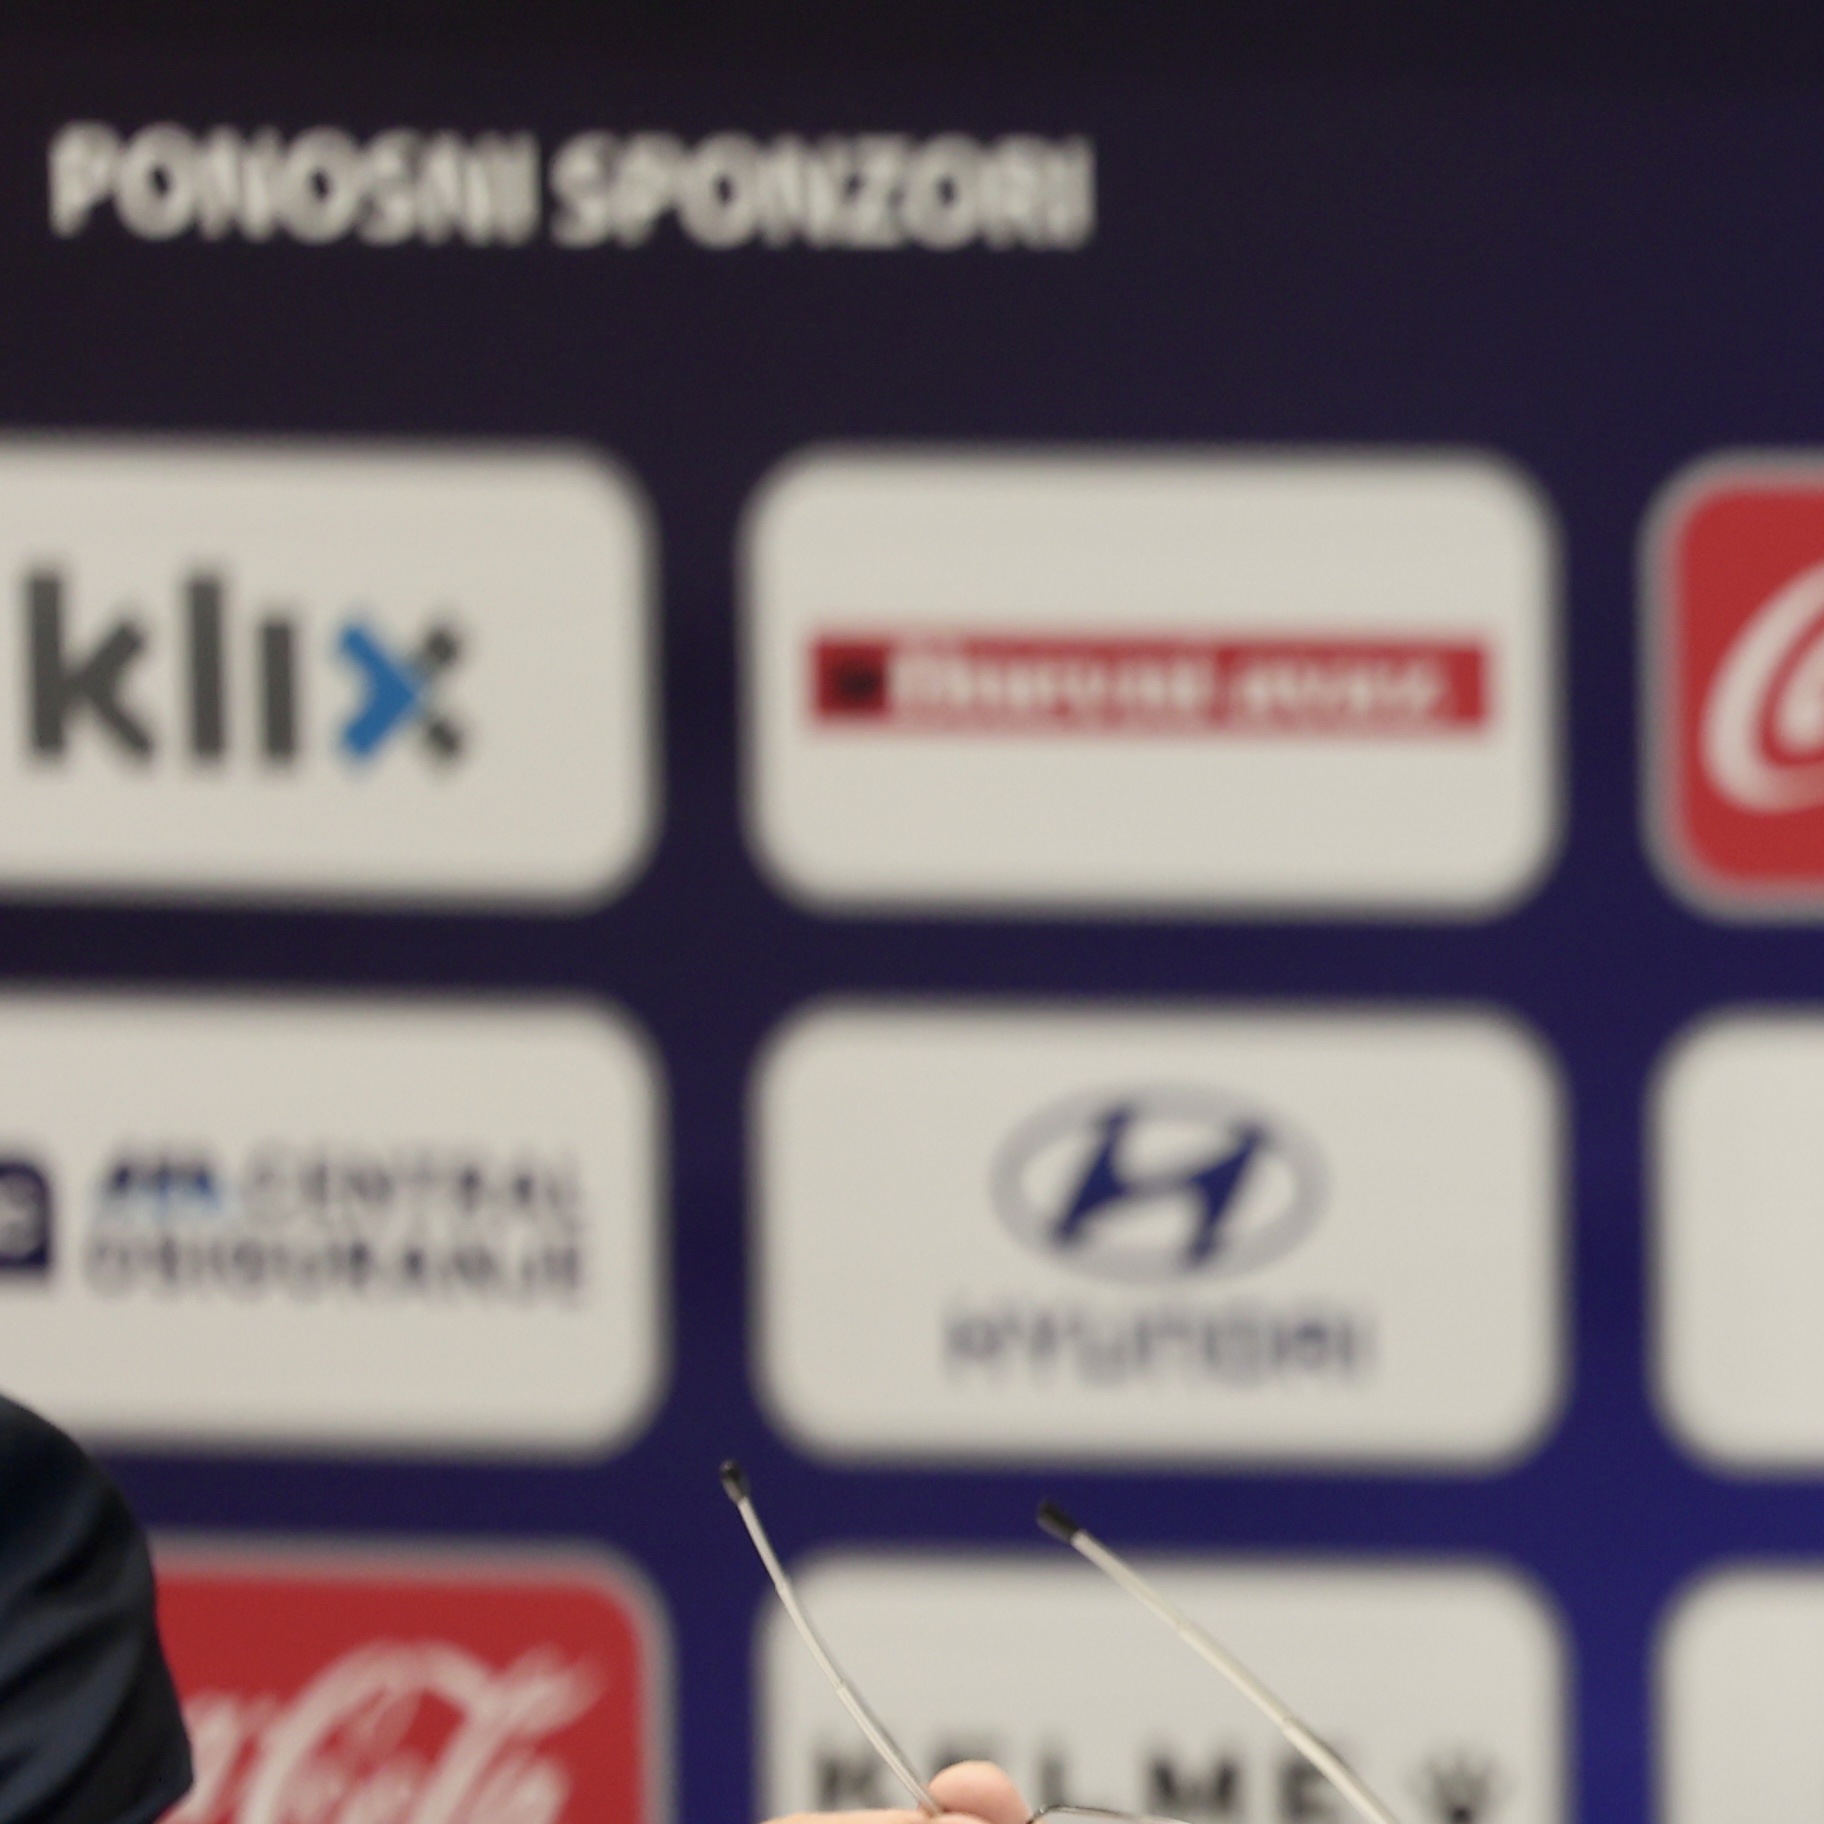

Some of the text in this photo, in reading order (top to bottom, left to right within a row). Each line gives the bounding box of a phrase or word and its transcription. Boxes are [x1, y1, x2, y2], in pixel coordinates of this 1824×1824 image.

[48, 123, 1098, 250] PONOSNI SPONZORI
[15, 560, 470, 776] klix
[243, 1138, 588, 1238] CENTRAL
[83, 1233, 588, 1308] OSIGURANJE
